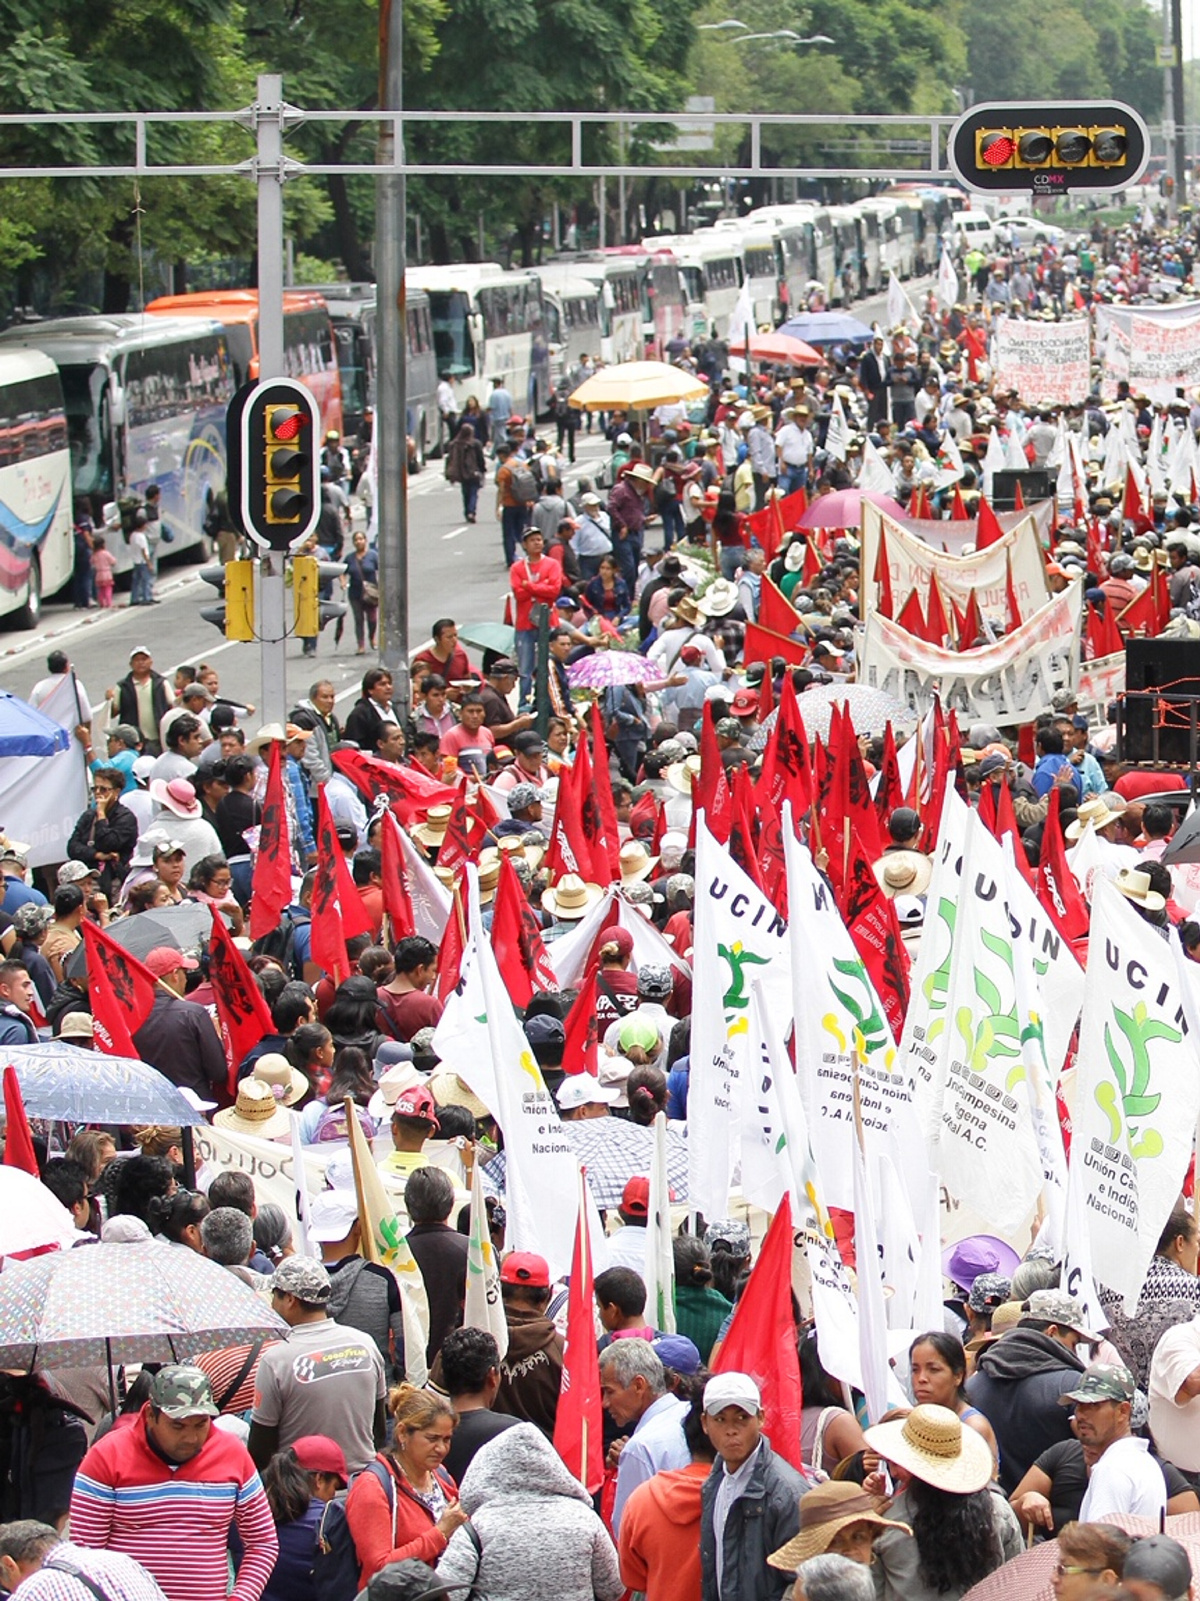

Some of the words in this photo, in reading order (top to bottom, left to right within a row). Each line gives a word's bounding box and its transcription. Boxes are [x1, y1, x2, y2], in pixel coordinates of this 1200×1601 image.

[1033, 174, 1065, 185] CDMX
[709, 876, 788, 938] UCIN
[1105, 937, 1190, 1037] UCIN
[531, 1142, 573, 1155] Naciona
[1083, 1152, 1116, 1181] Unión
[1098, 1183, 1106, 1194] e
[1086, 1192, 1136, 1231] Nacional
[321, 1347, 367, 1362] GOODYEAR
